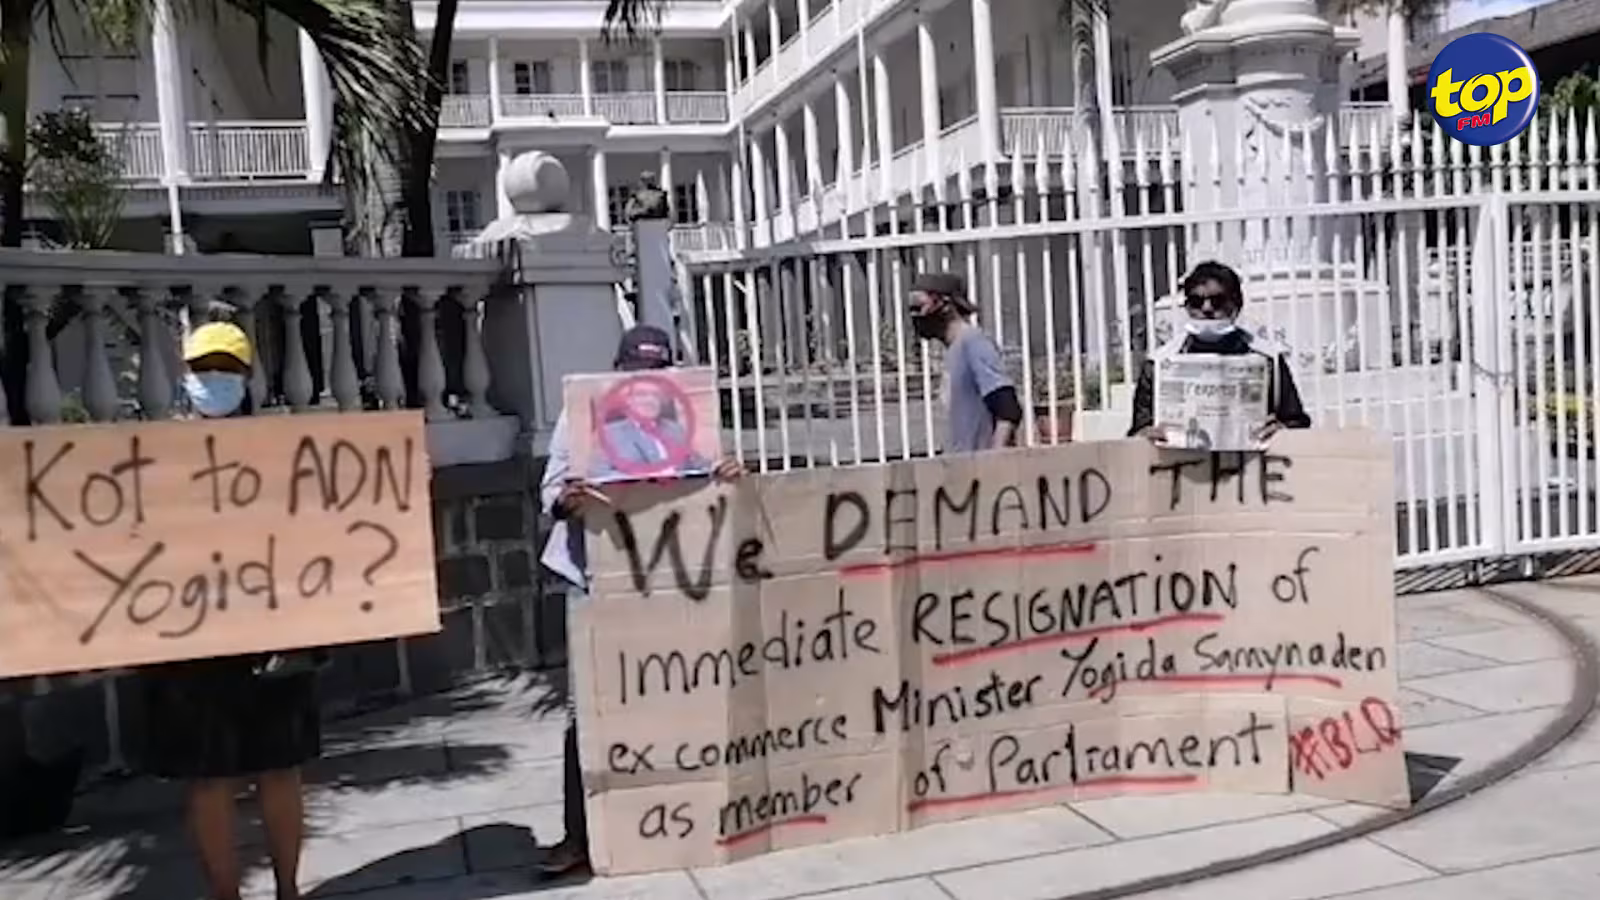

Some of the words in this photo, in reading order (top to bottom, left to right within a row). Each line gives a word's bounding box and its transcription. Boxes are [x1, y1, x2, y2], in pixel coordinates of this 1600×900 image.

[24, 435, 156, 540] Kot
[193, 435, 261, 512] to
[289, 435, 413, 516] ADN
[614, 495, 773, 602] We
[823, 468, 1111, 561] DEMAND
[1149, 450, 1294, 510] THE
[619, 587, 880, 704] Immediate
[1272, 546, 1320, 603] of
[608, 742, 656, 774] ex
[675, 712, 848, 771] commerce
[873, 670, 1043, 734] Minister
[1061, 637, 1177, 702] Yogida
[1194, 632, 1386, 691] Samynaden
[638, 800, 695, 840] as
[717, 773, 862, 836] member
[914, 742, 951, 797] of
[988, 712, 1274, 794] Parliament
